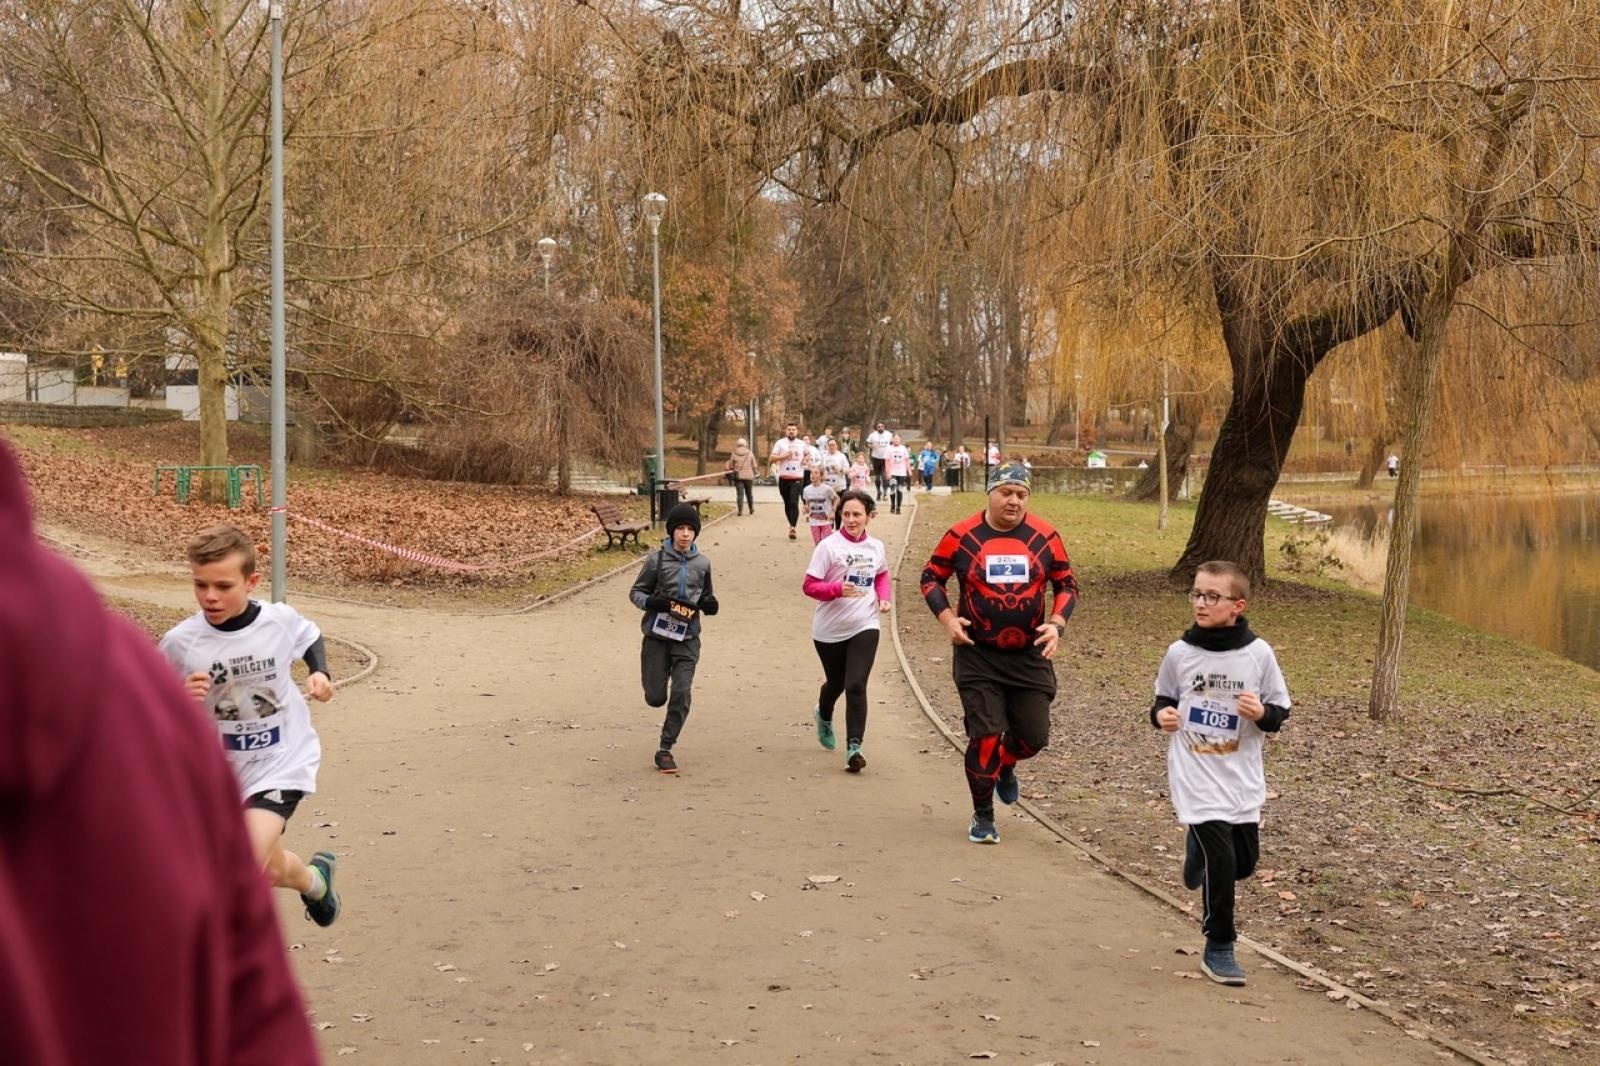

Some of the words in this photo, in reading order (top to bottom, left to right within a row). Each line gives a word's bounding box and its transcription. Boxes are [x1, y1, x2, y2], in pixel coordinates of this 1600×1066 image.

[1004, 565, 1012, 575] 2
[231, 657, 276, 676] WILCZYM
[1208, 680, 1244, 690] WILCZYM
[1200, 711, 1230, 728] 108
[236, 731, 272, 750] 129
